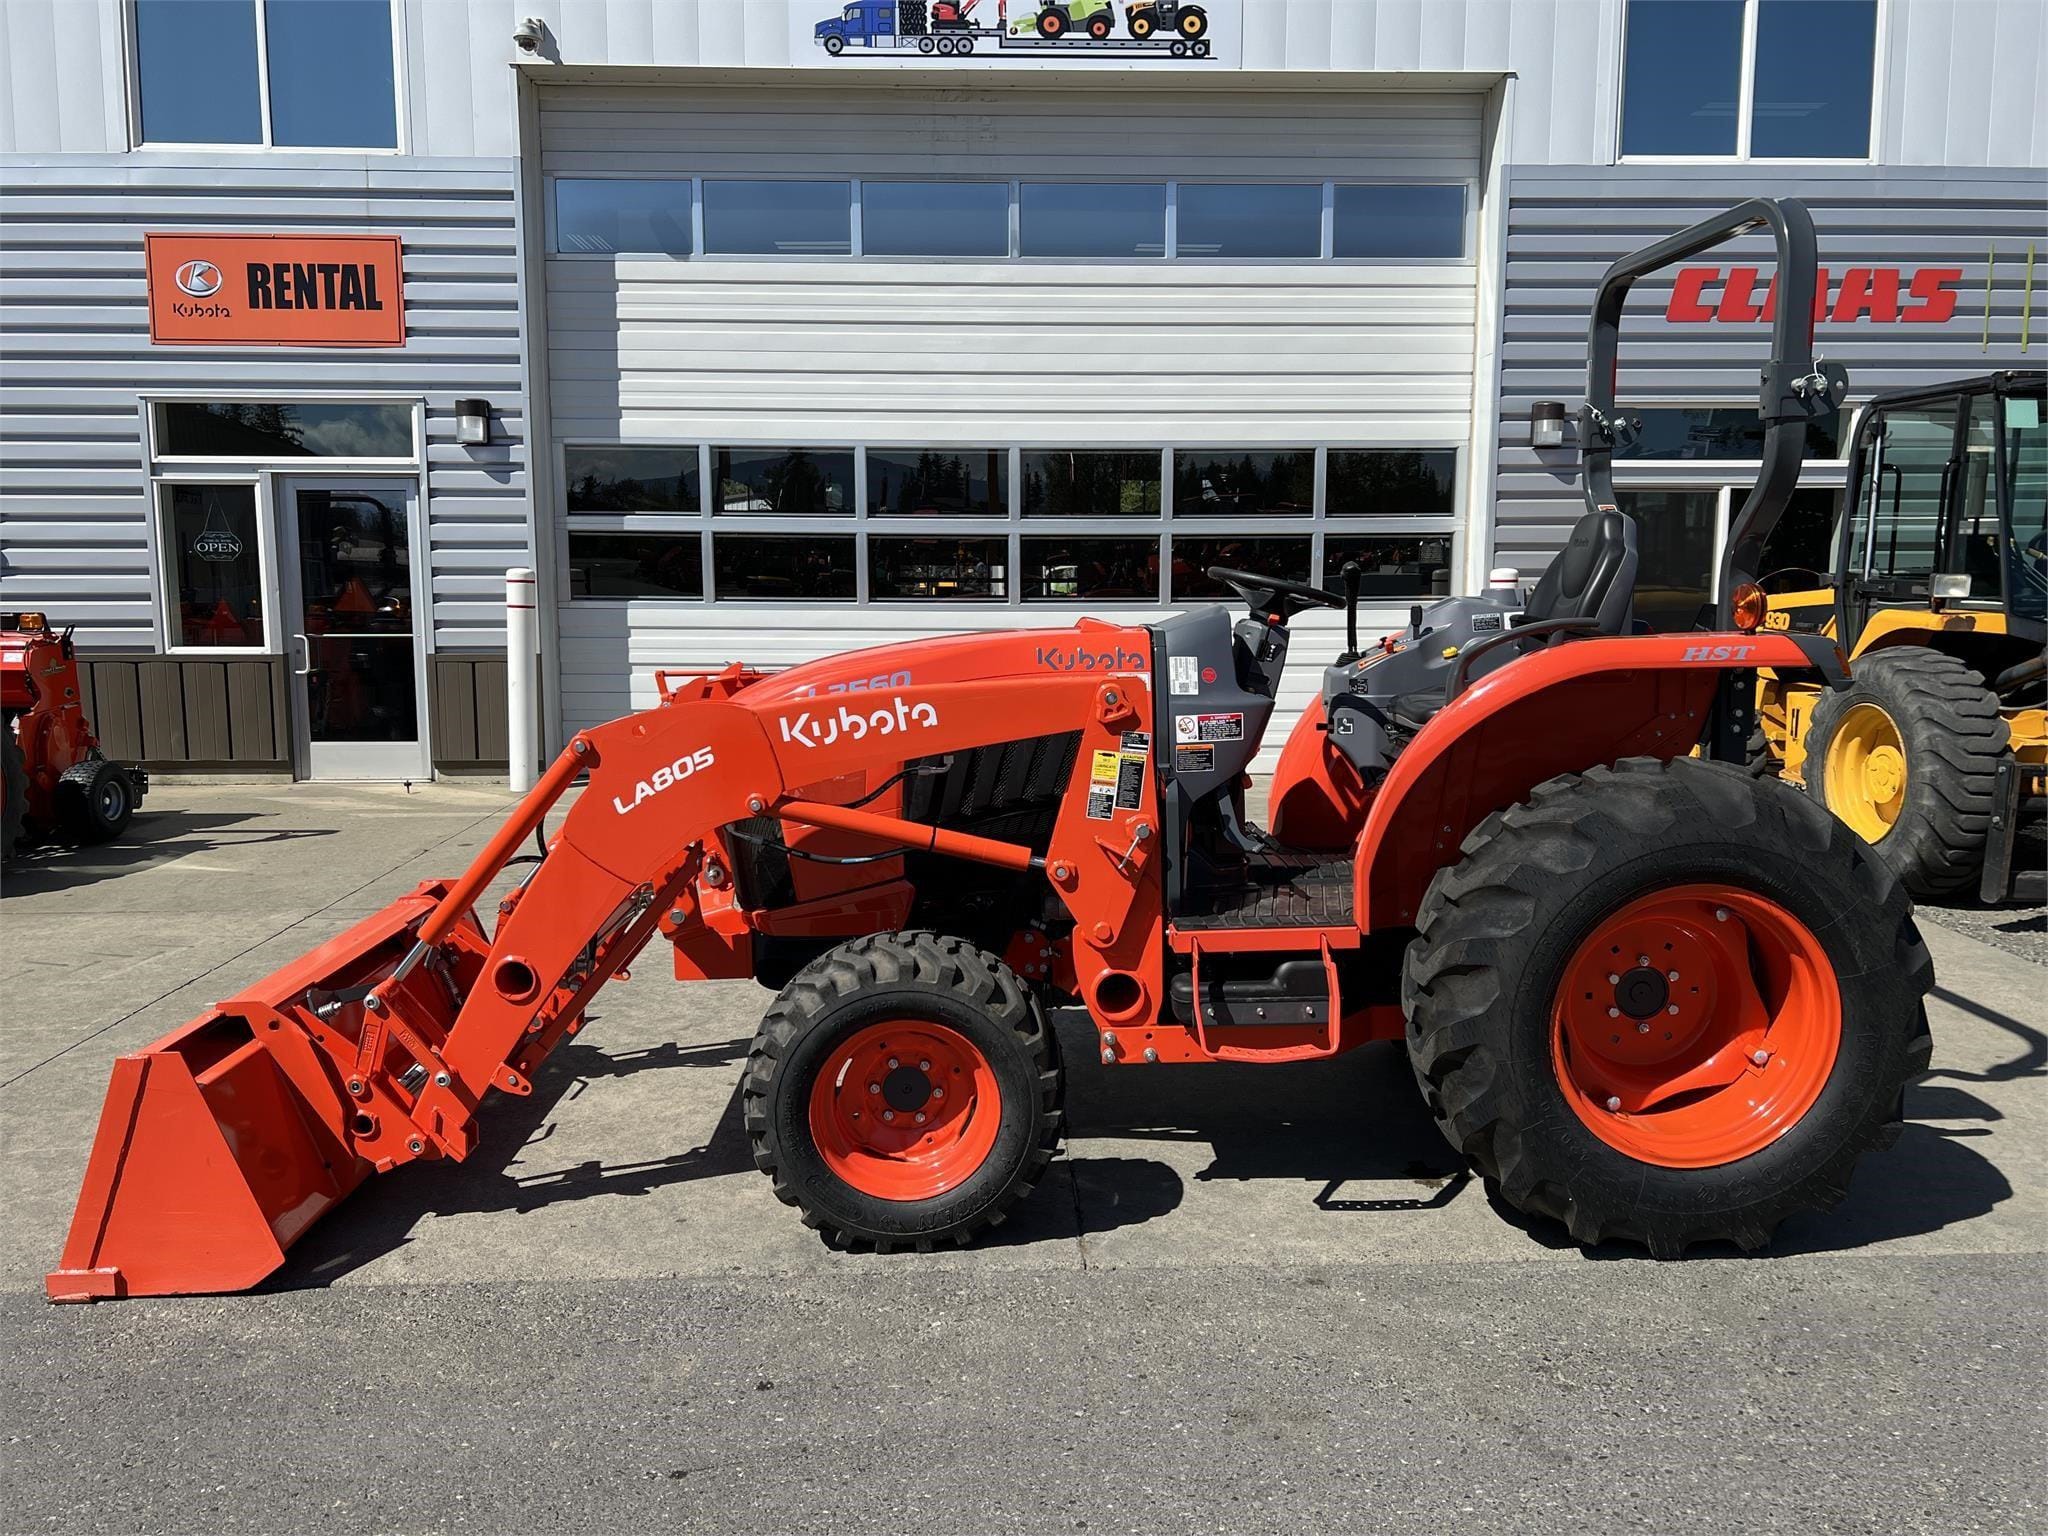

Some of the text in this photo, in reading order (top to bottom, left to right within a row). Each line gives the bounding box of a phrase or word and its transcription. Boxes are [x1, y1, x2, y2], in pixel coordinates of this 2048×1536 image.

[246, 262, 383, 311] RENTAL
[172, 303, 232, 318] Kubota
[196, 542, 240, 553] OPEN
[1765, 611, 1791, 631] 930
[1036, 646, 1145, 671] Kubota
[1680, 646, 1757, 661] HST
[779, 697, 938, 748] Kubota
[613, 745, 715, 815] LA805
